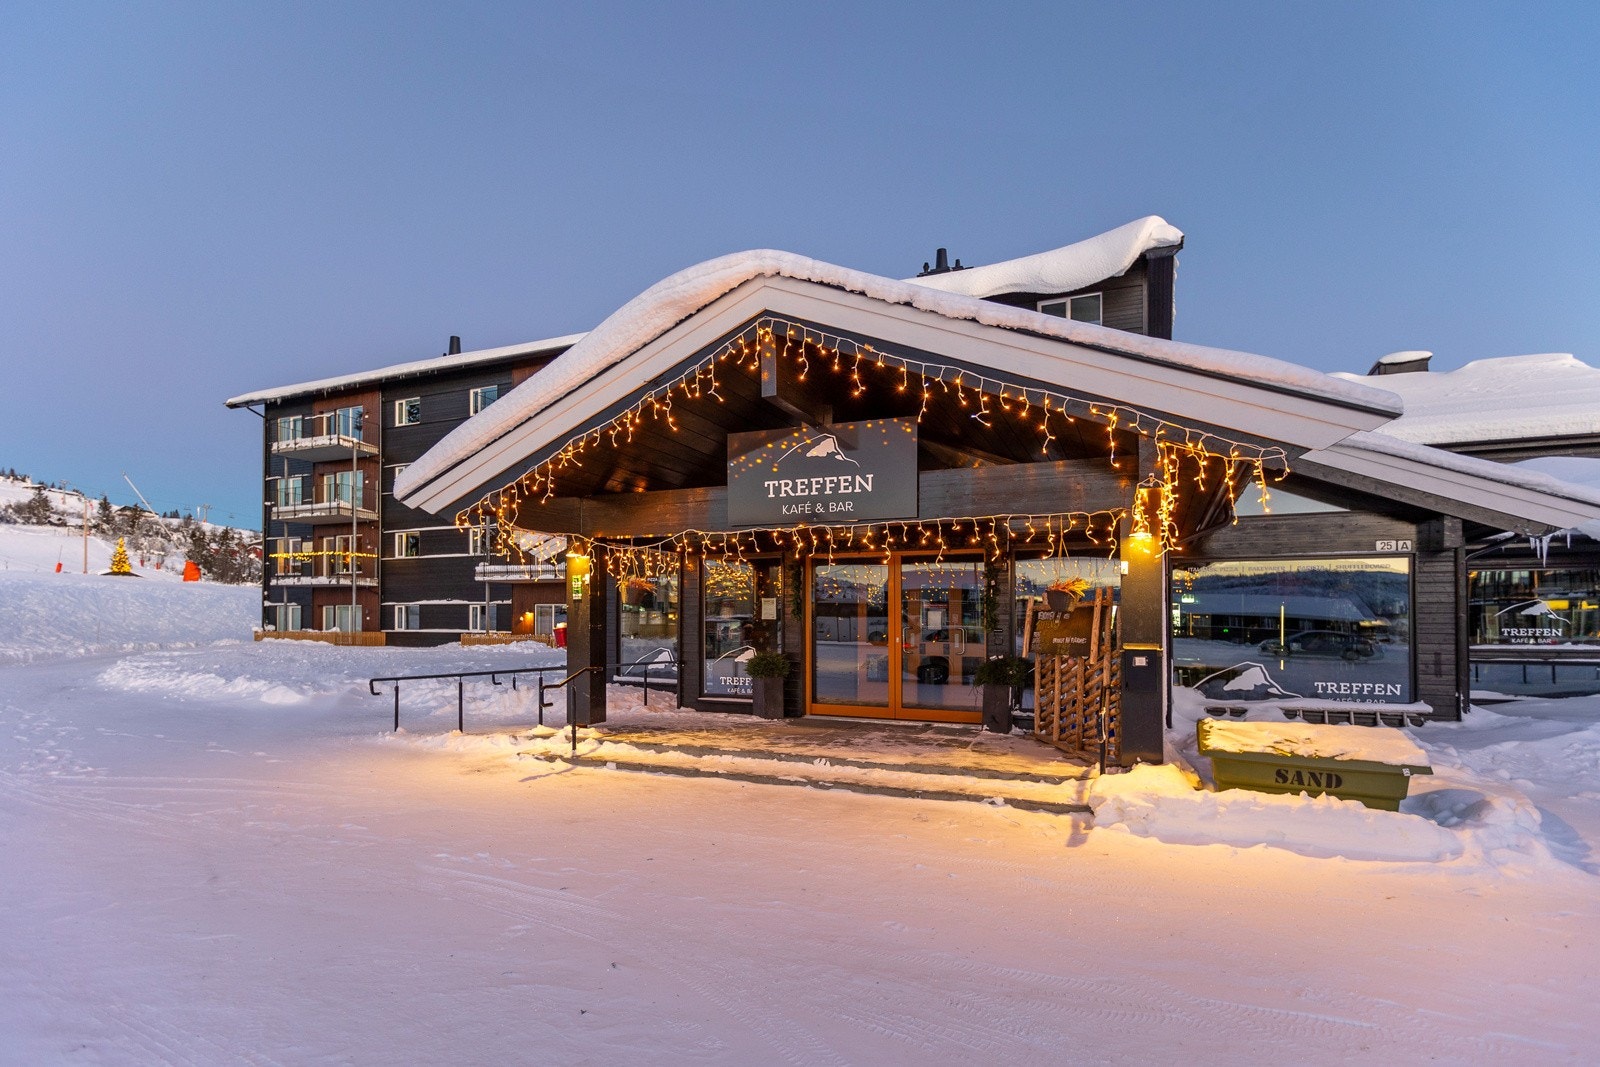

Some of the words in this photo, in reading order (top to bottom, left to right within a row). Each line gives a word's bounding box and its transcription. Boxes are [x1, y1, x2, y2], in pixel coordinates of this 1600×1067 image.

[764, 474, 874, 498] TREFFEN
[782, 501, 812, 515] KAFÉ
[815, 502, 825, 513] &
[829, 501, 854, 512] BAR
[1380, 541, 1393, 551] 25
[1400, 541, 1409, 550] A
[1501, 628, 1563, 637] TREFFEN
[720, 676, 753, 686] TREFF
[1314, 682, 1402, 696] TREFFEN
[1275, 768, 1343, 789] SAND
